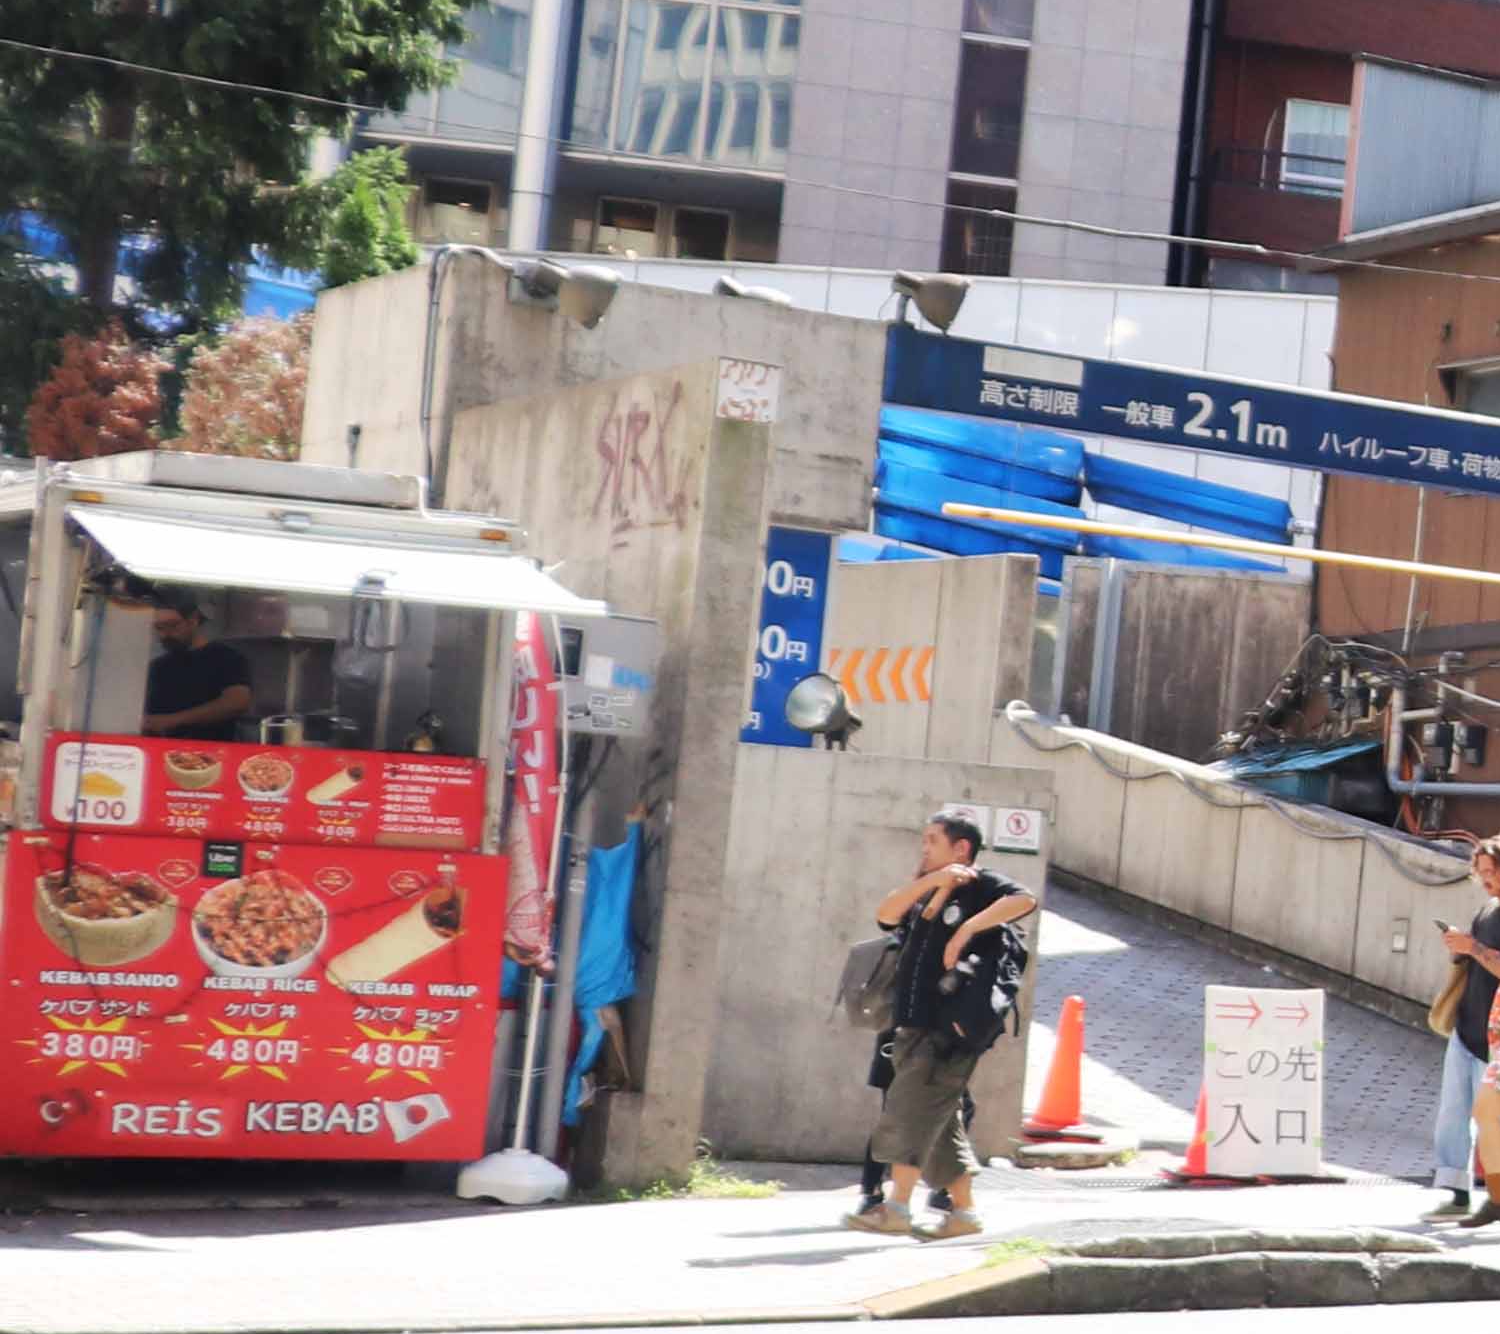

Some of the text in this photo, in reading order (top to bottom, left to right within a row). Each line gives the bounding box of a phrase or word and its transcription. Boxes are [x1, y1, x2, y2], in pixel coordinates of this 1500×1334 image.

[979, 378, 1080, 418] 高さ制限
[1101, 399, 1176, 429] 一般車
[1183, 391, 1288, 449] 2.1m
[39, 970, 180, 988] KEBAB SANDO
[203, 976, 267, 991] KEBAB
[350, 982, 480, 997] KEBAB WRAP
[99, 999, 152, 1016] サンド
[41, 1031, 135, 1060] 380円
[206, 1037, 300, 1064] 480円
[350, 1041, 442, 1068] 480円
[1214, 1043, 1318, 1083] この先
[246, 1100, 381, 1134] KEBAB
[1212, 1102, 1308, 1147] 入口
